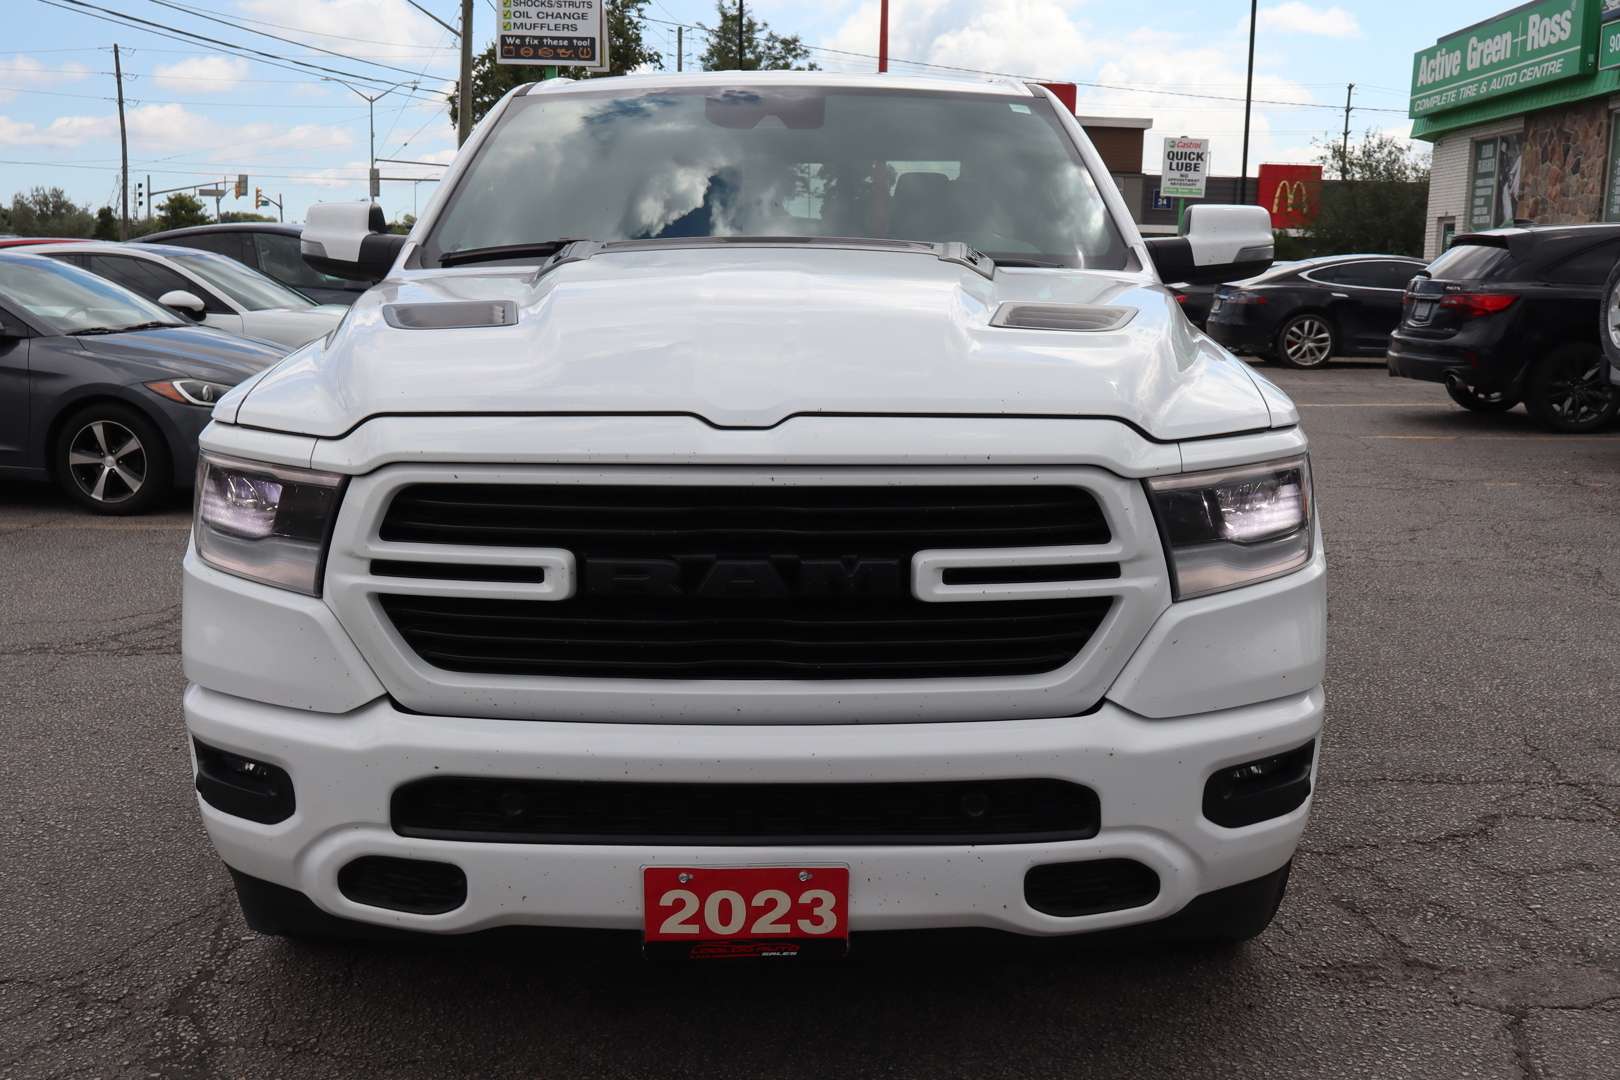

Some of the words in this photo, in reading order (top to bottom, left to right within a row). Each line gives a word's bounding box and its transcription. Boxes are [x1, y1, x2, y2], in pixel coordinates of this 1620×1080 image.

[513, 0, 592, 8] SHOCKS/STRUTS
[513, 11, 532, 19] OIL
[537, 11, 589, 20] CHANGE
[513, 22, 578, 32] MUFFLERS
[505, 36, 521, 45] We
[525, 36, 540, 46] fix
[543, 38, 569, 46] these
[1417, 48, 1462, 88] Active
[1414, 89, 1457, 112] COMPLETE
[1459, 83, 1479, 100] TIRE
[1480, 81, 1487, 94] &
[1489, 71, 1517, 91] AUTO
[1519, 58, 1565, 83] CENTRE
[1167, 151, 1204, 161] QUICK
[1169, 162, 1201, 172] LUBE
[584, 557, 901, 598] RAM
[659, 889, 838, 935] 2023
